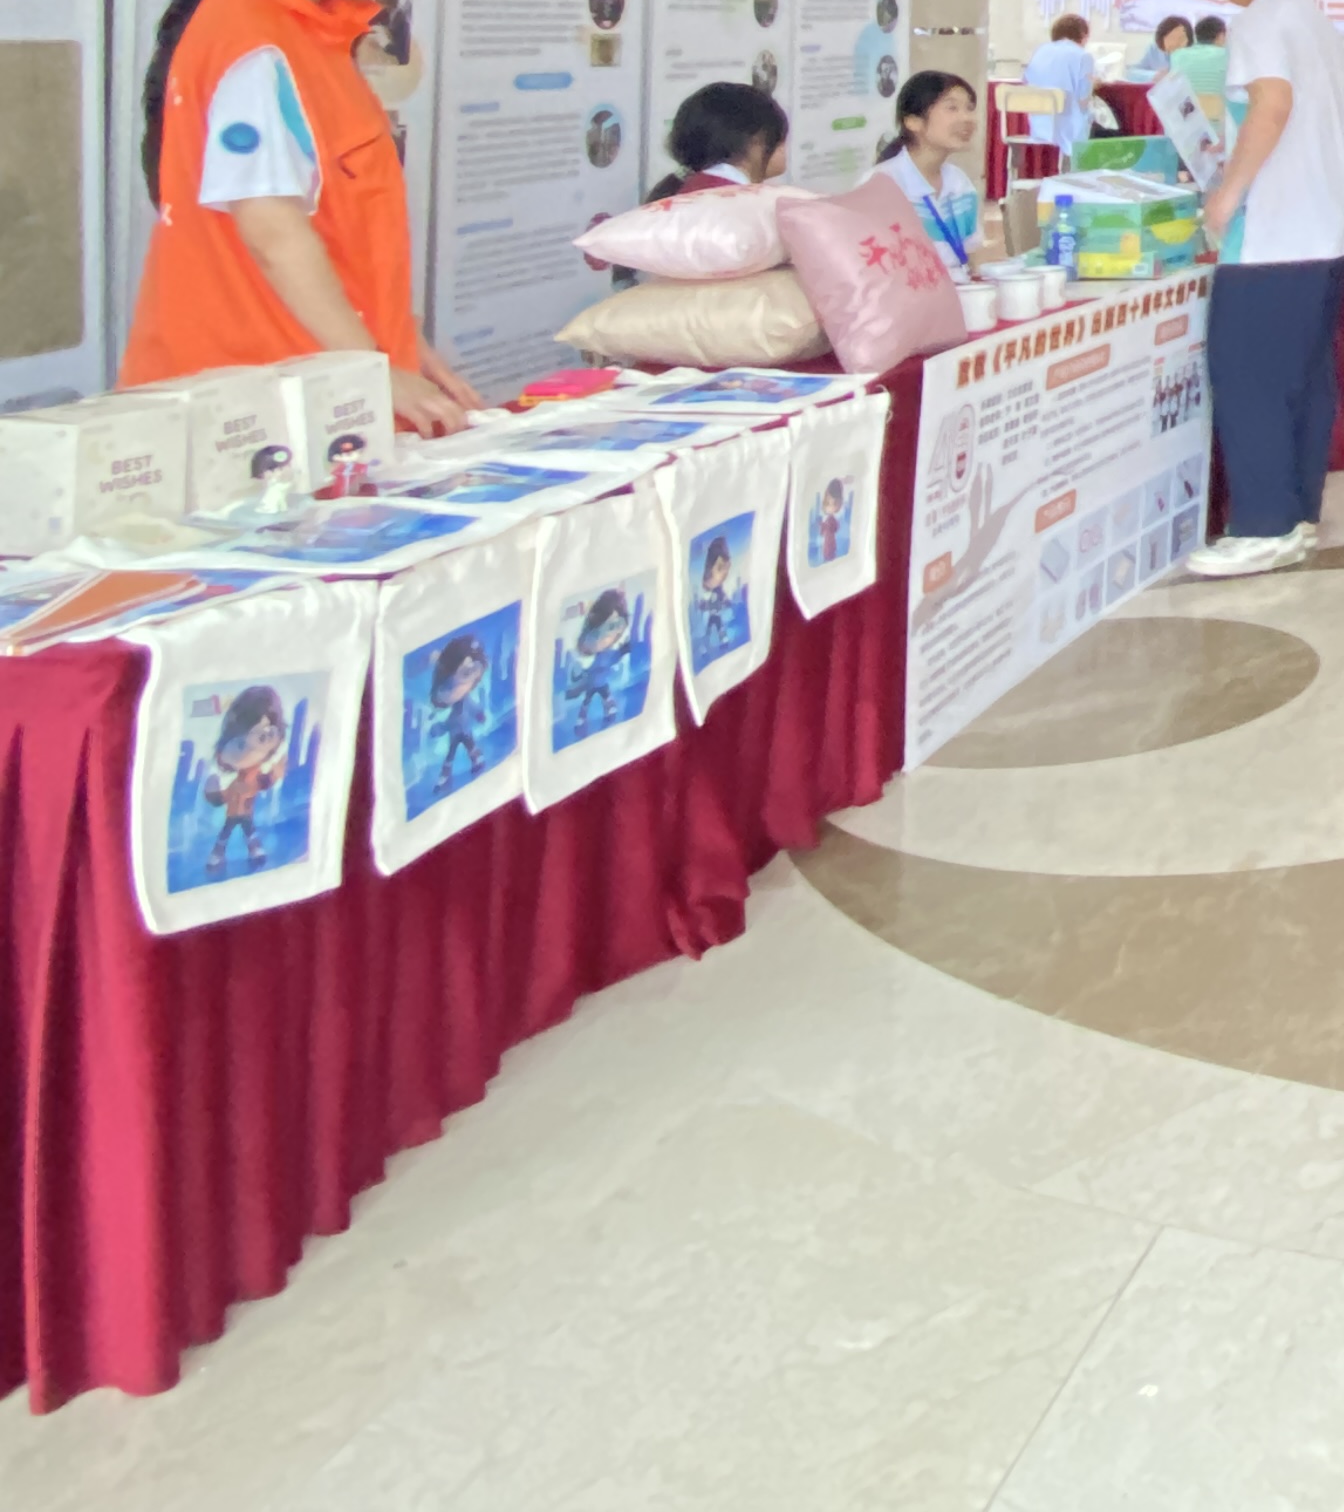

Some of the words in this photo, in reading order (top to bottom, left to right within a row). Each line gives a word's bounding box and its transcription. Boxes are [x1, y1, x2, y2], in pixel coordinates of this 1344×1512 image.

[333, 398, 365, 418] BEST
[223, 414, 257, 435] BEST
[111, 454, 152, 476] BEST
